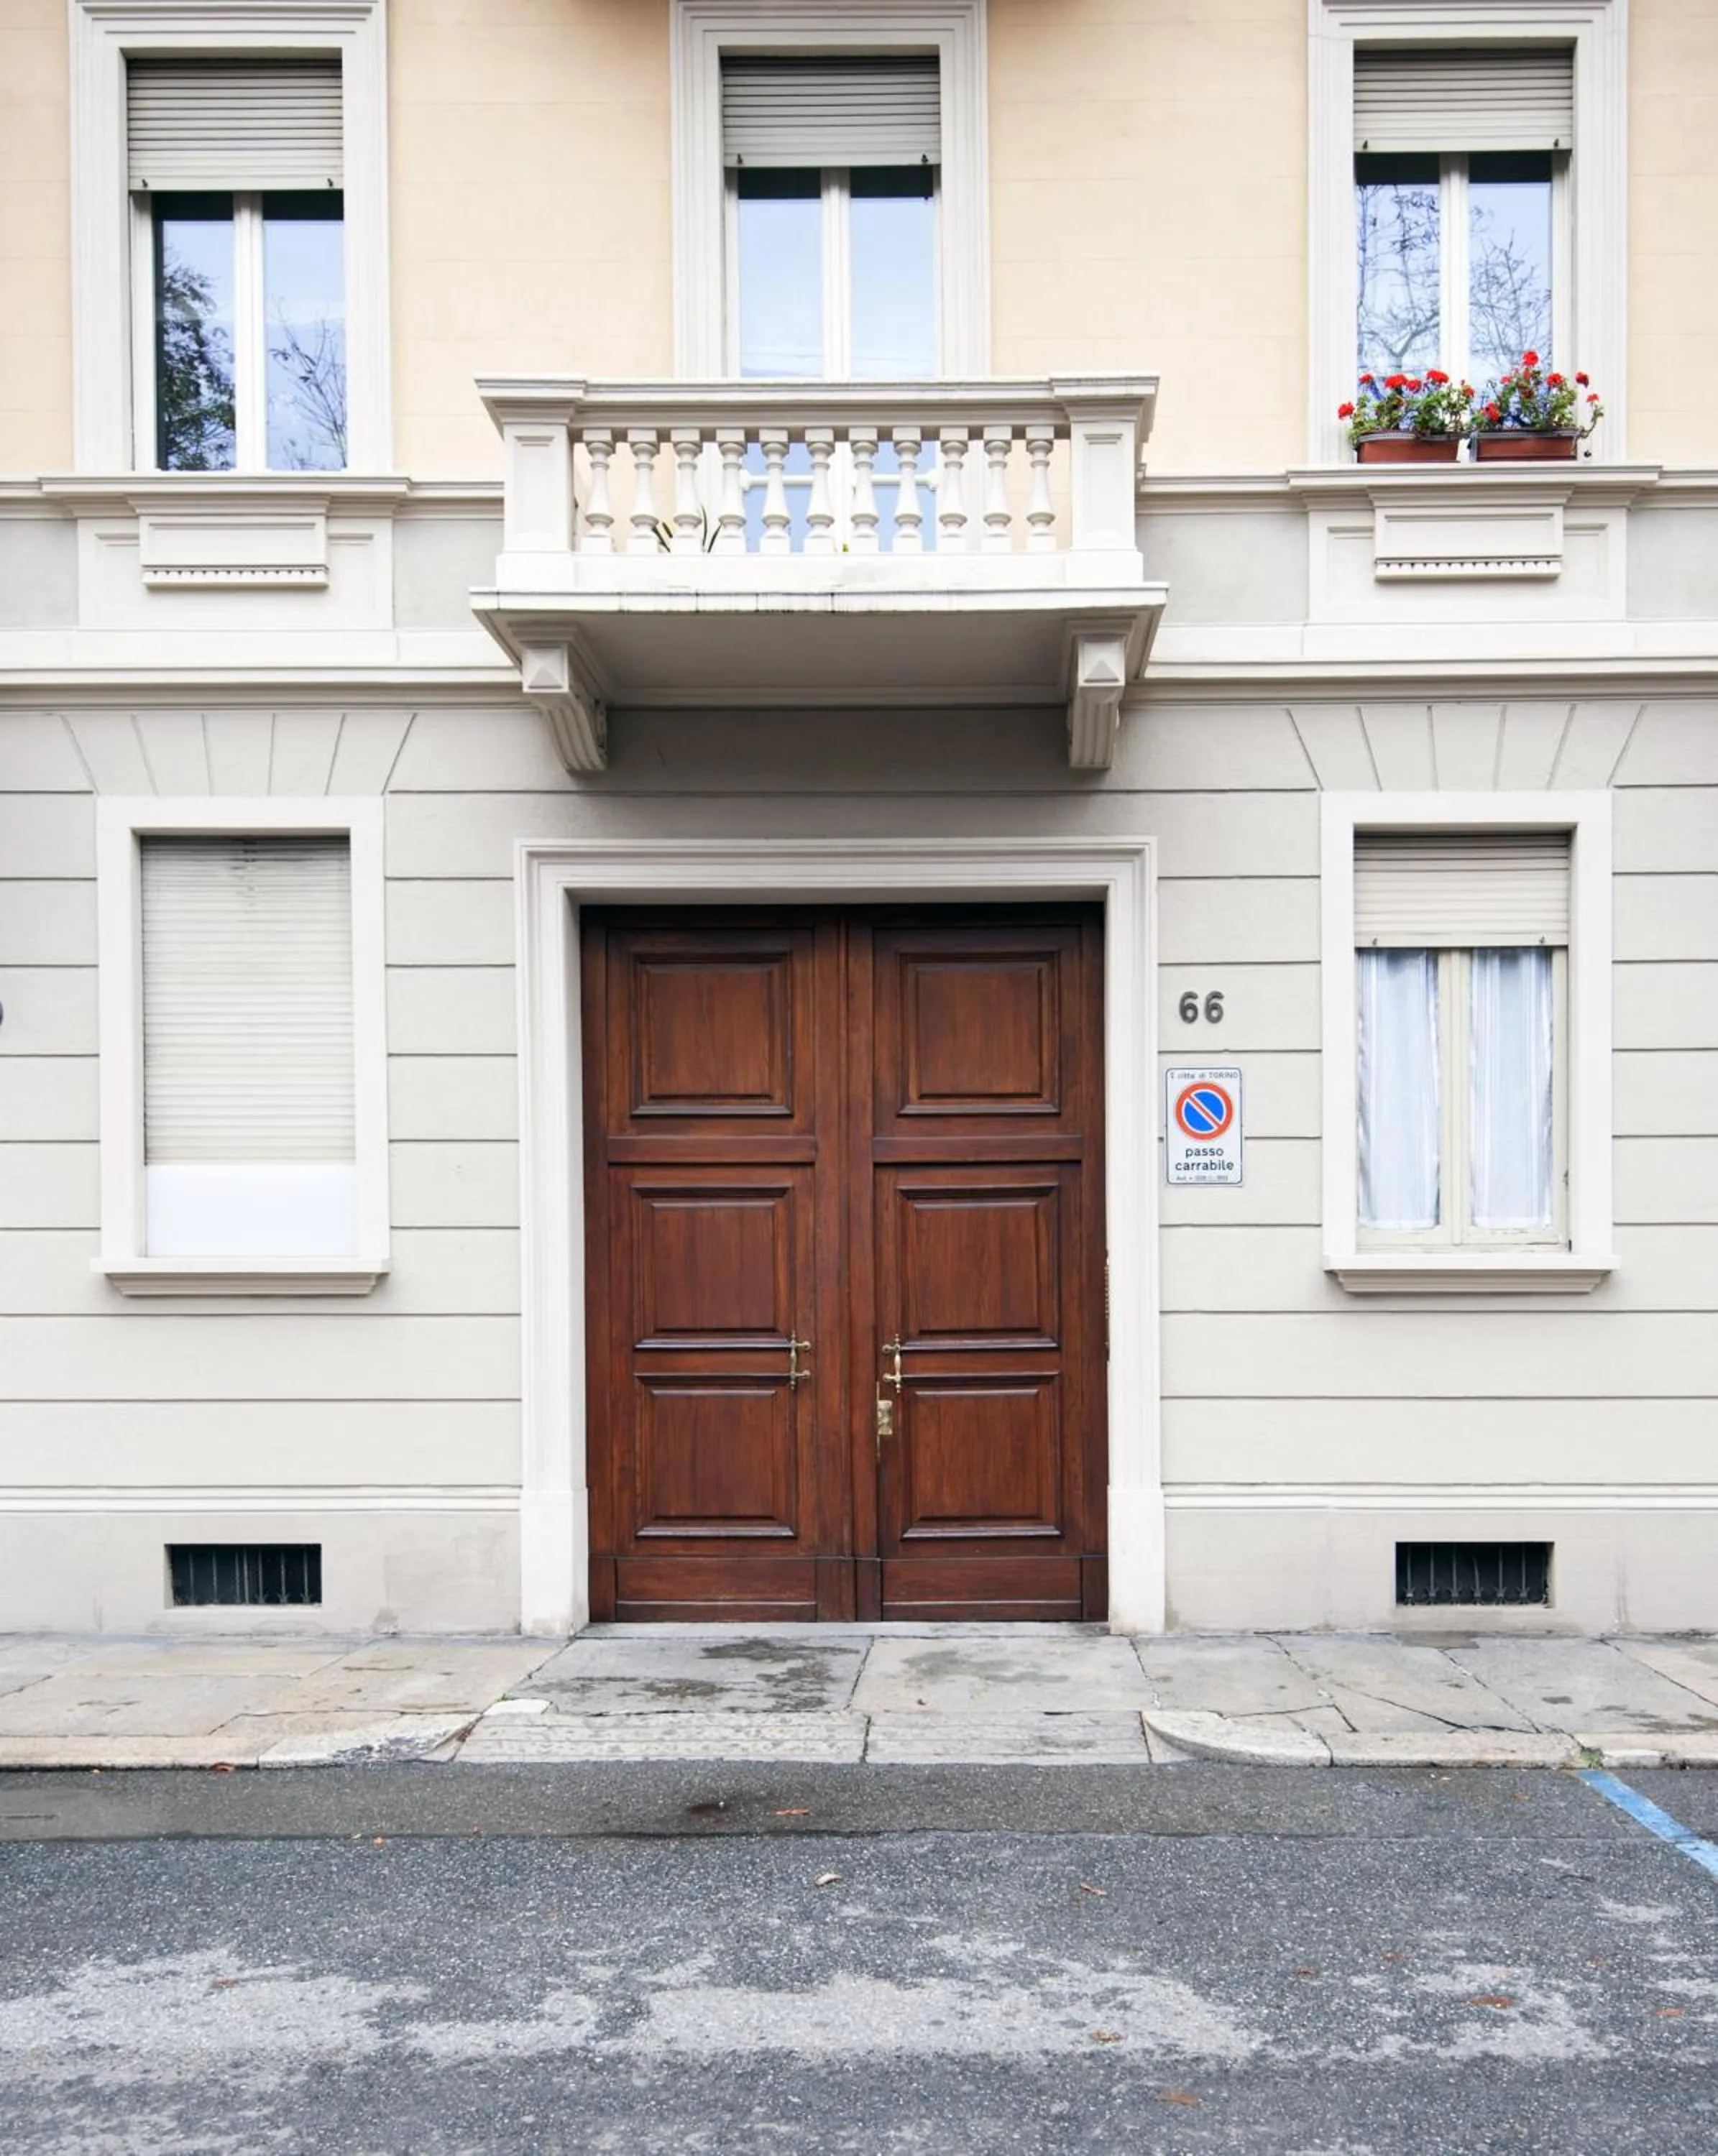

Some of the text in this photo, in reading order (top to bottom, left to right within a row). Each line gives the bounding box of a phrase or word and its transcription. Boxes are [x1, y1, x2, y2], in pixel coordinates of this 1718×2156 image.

[1179, 990, 1225, 1024] 66
[1185, 1148, 1224, 1159] passo
[1175, 1160, 1234, 1171] carrabile
